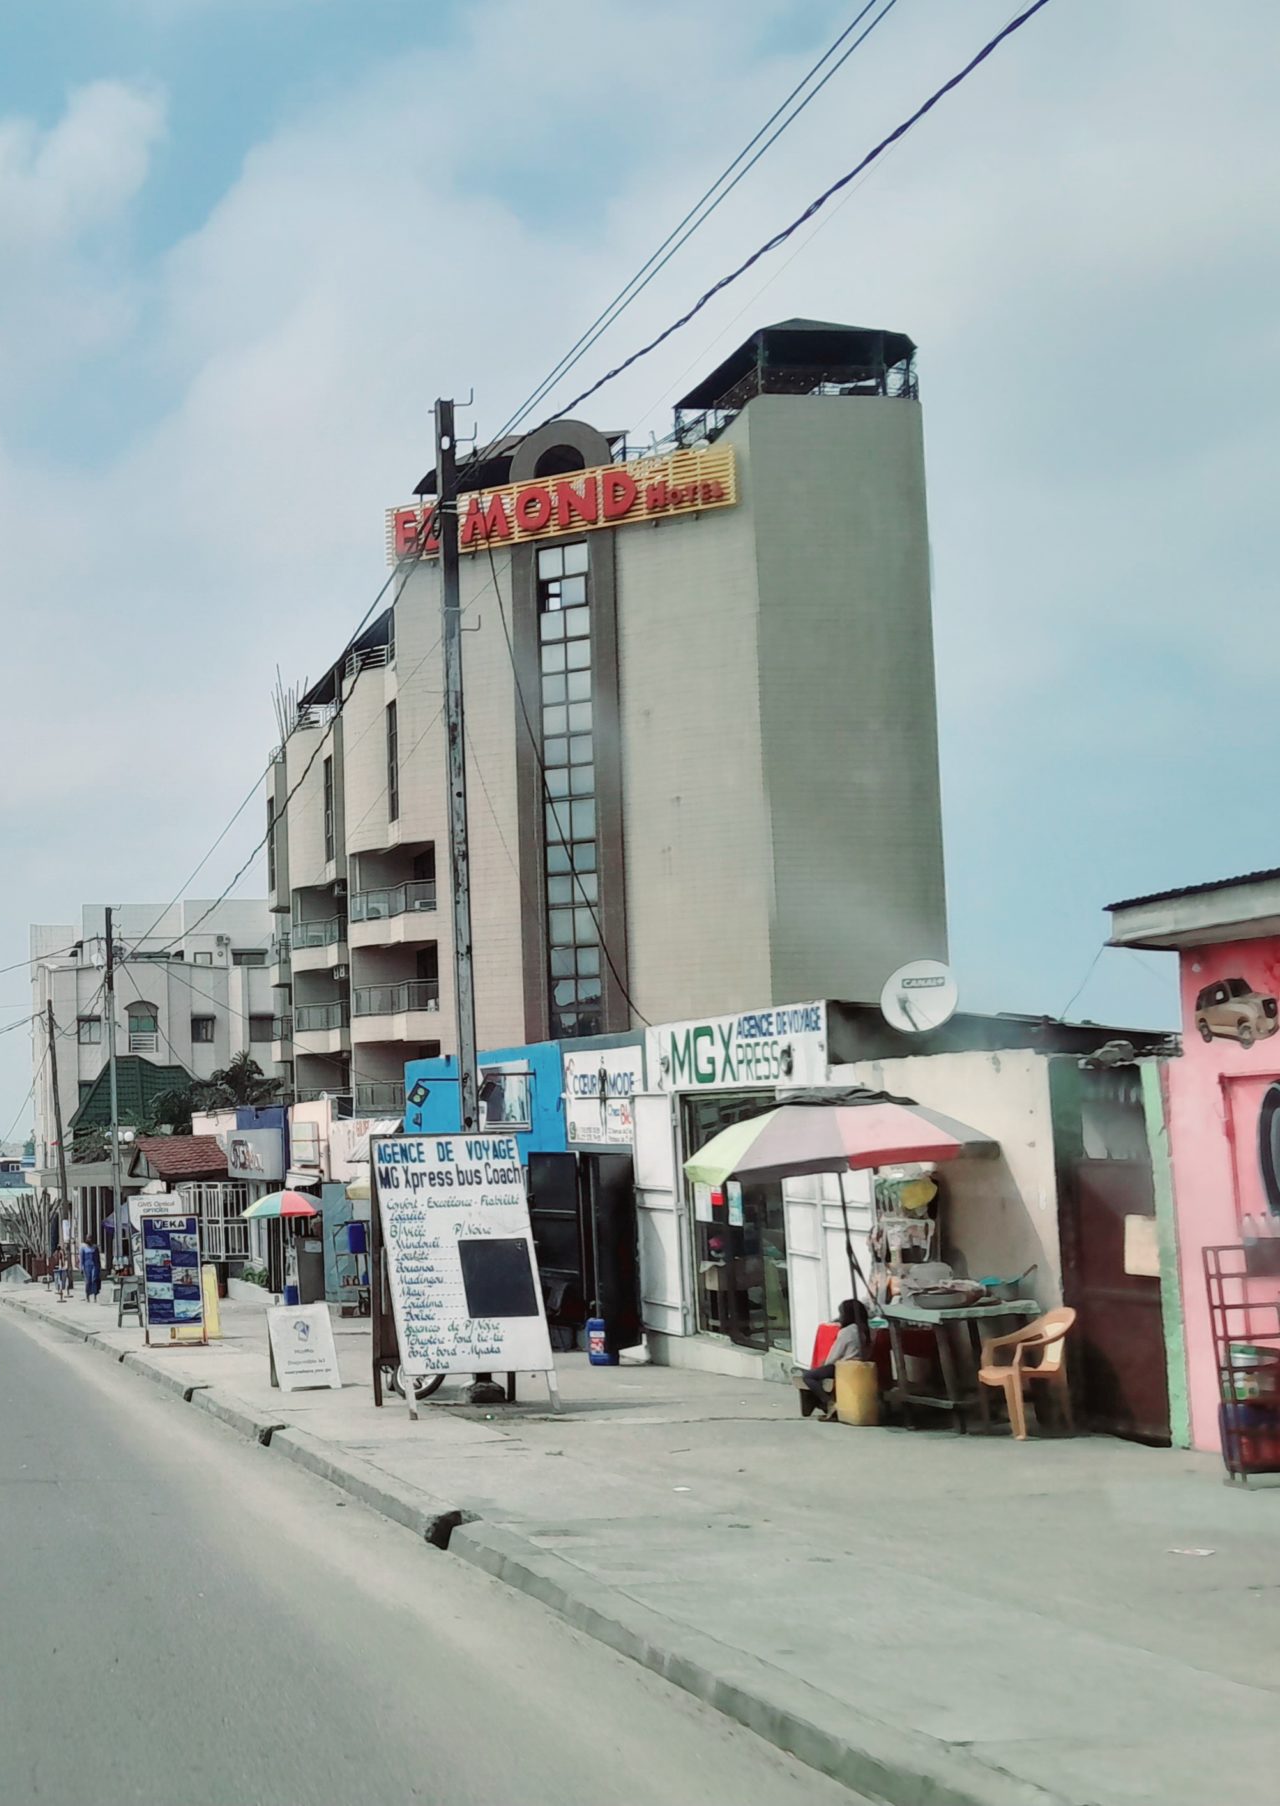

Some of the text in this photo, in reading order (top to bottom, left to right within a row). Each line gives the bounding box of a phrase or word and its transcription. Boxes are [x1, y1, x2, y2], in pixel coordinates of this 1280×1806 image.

[607, 1072, 634, 1095] MODE
[377, 1138, 516, 1164] AGENCE DE VOYAGE
[378, 1161, 521, 1194] MG Xpress bus Coach
[153, 1219, 185, 1230] VEKA
